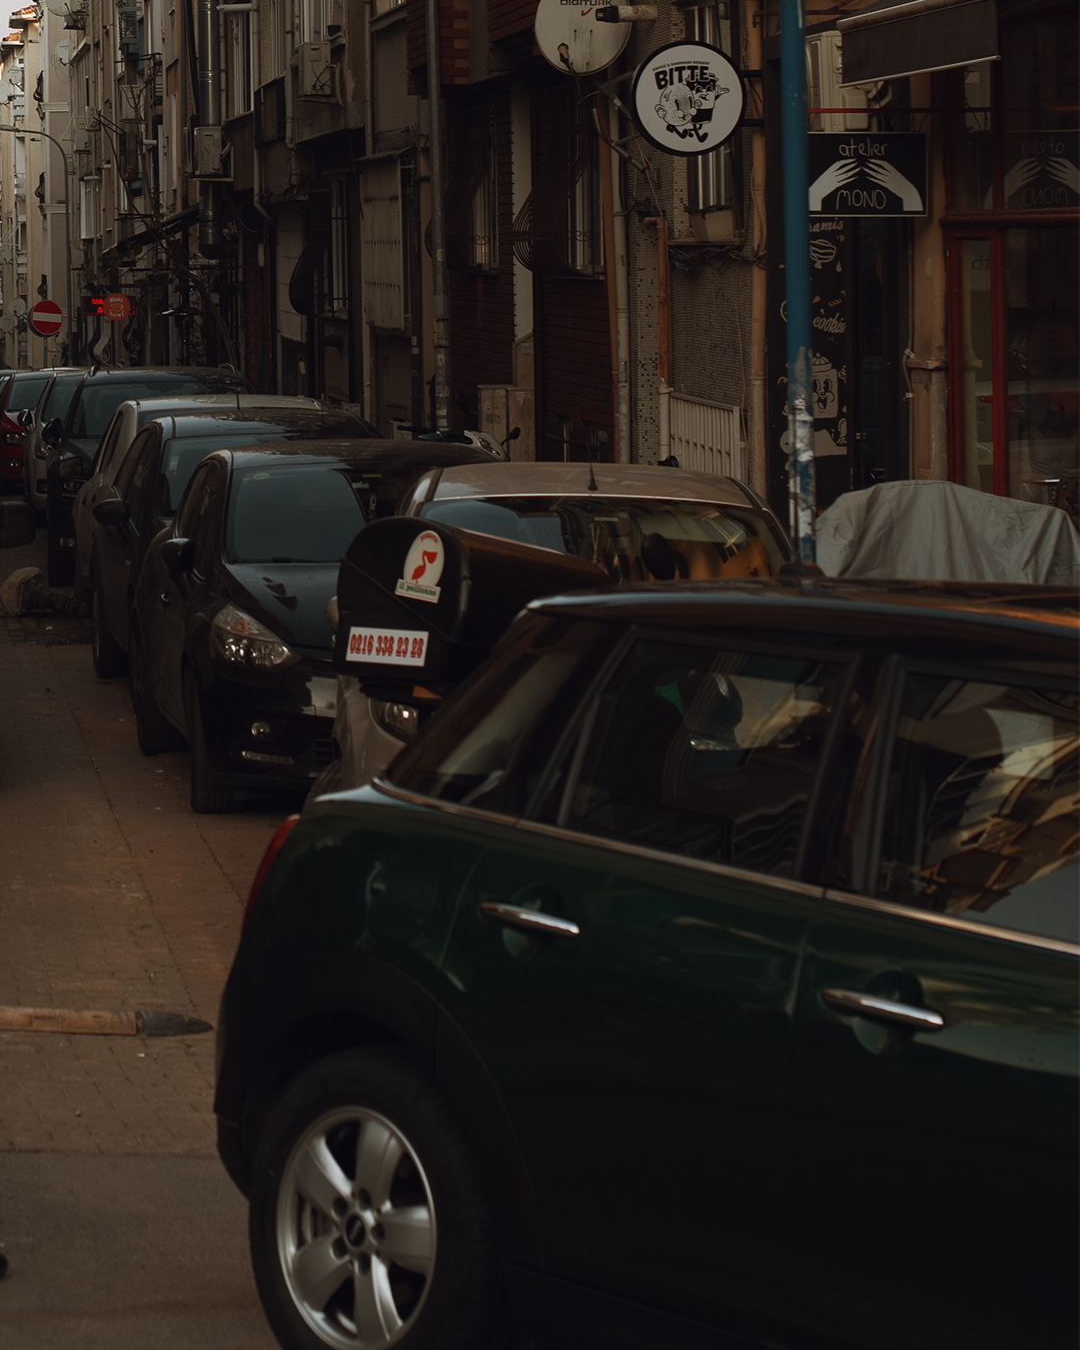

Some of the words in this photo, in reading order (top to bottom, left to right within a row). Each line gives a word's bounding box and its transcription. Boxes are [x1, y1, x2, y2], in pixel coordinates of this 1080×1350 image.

[652, 64, 667, 72] COFFEE
[654, 65, 709, 91] BITTE
[838, 137, 889, 157] atelier
[836, 189, 887, 210] MONO
[812, 312, 847, 334] cookie
[350, 633, 374, 656] 0216
[376, 634, 395, 657] 338
[395, 636, 410, 658] 23
[410, 637, 424, 659] 28
